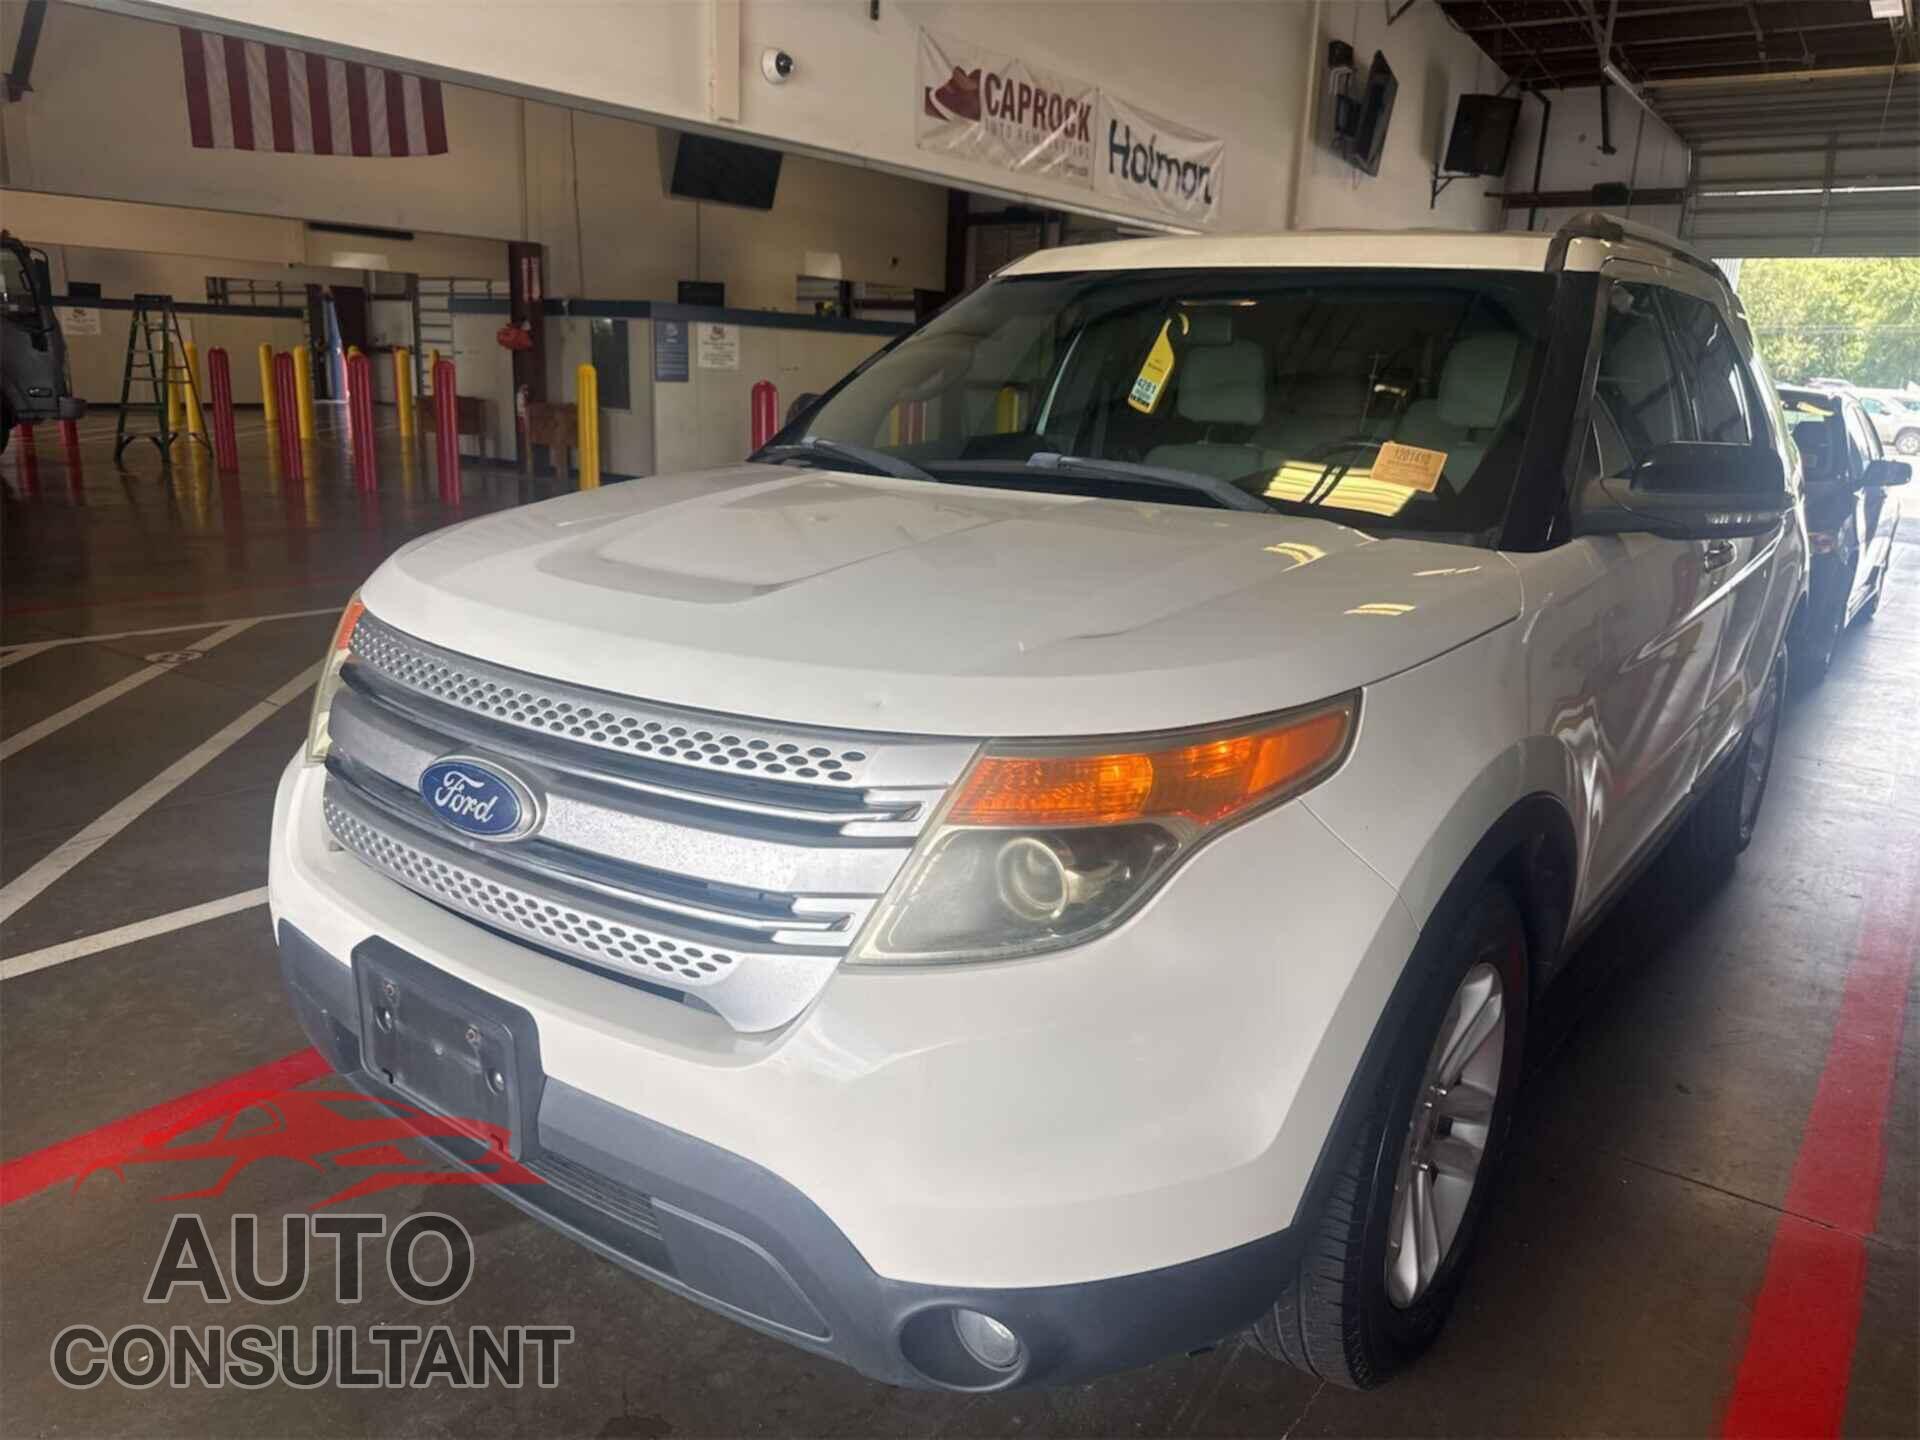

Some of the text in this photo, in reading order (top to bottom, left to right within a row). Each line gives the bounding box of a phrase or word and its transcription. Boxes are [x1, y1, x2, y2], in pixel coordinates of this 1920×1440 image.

[984, 72, 1092, 143] CAPROCK
[1108, 117, 1212, 205] Holman
[434, 770, 499, 823] Ford
